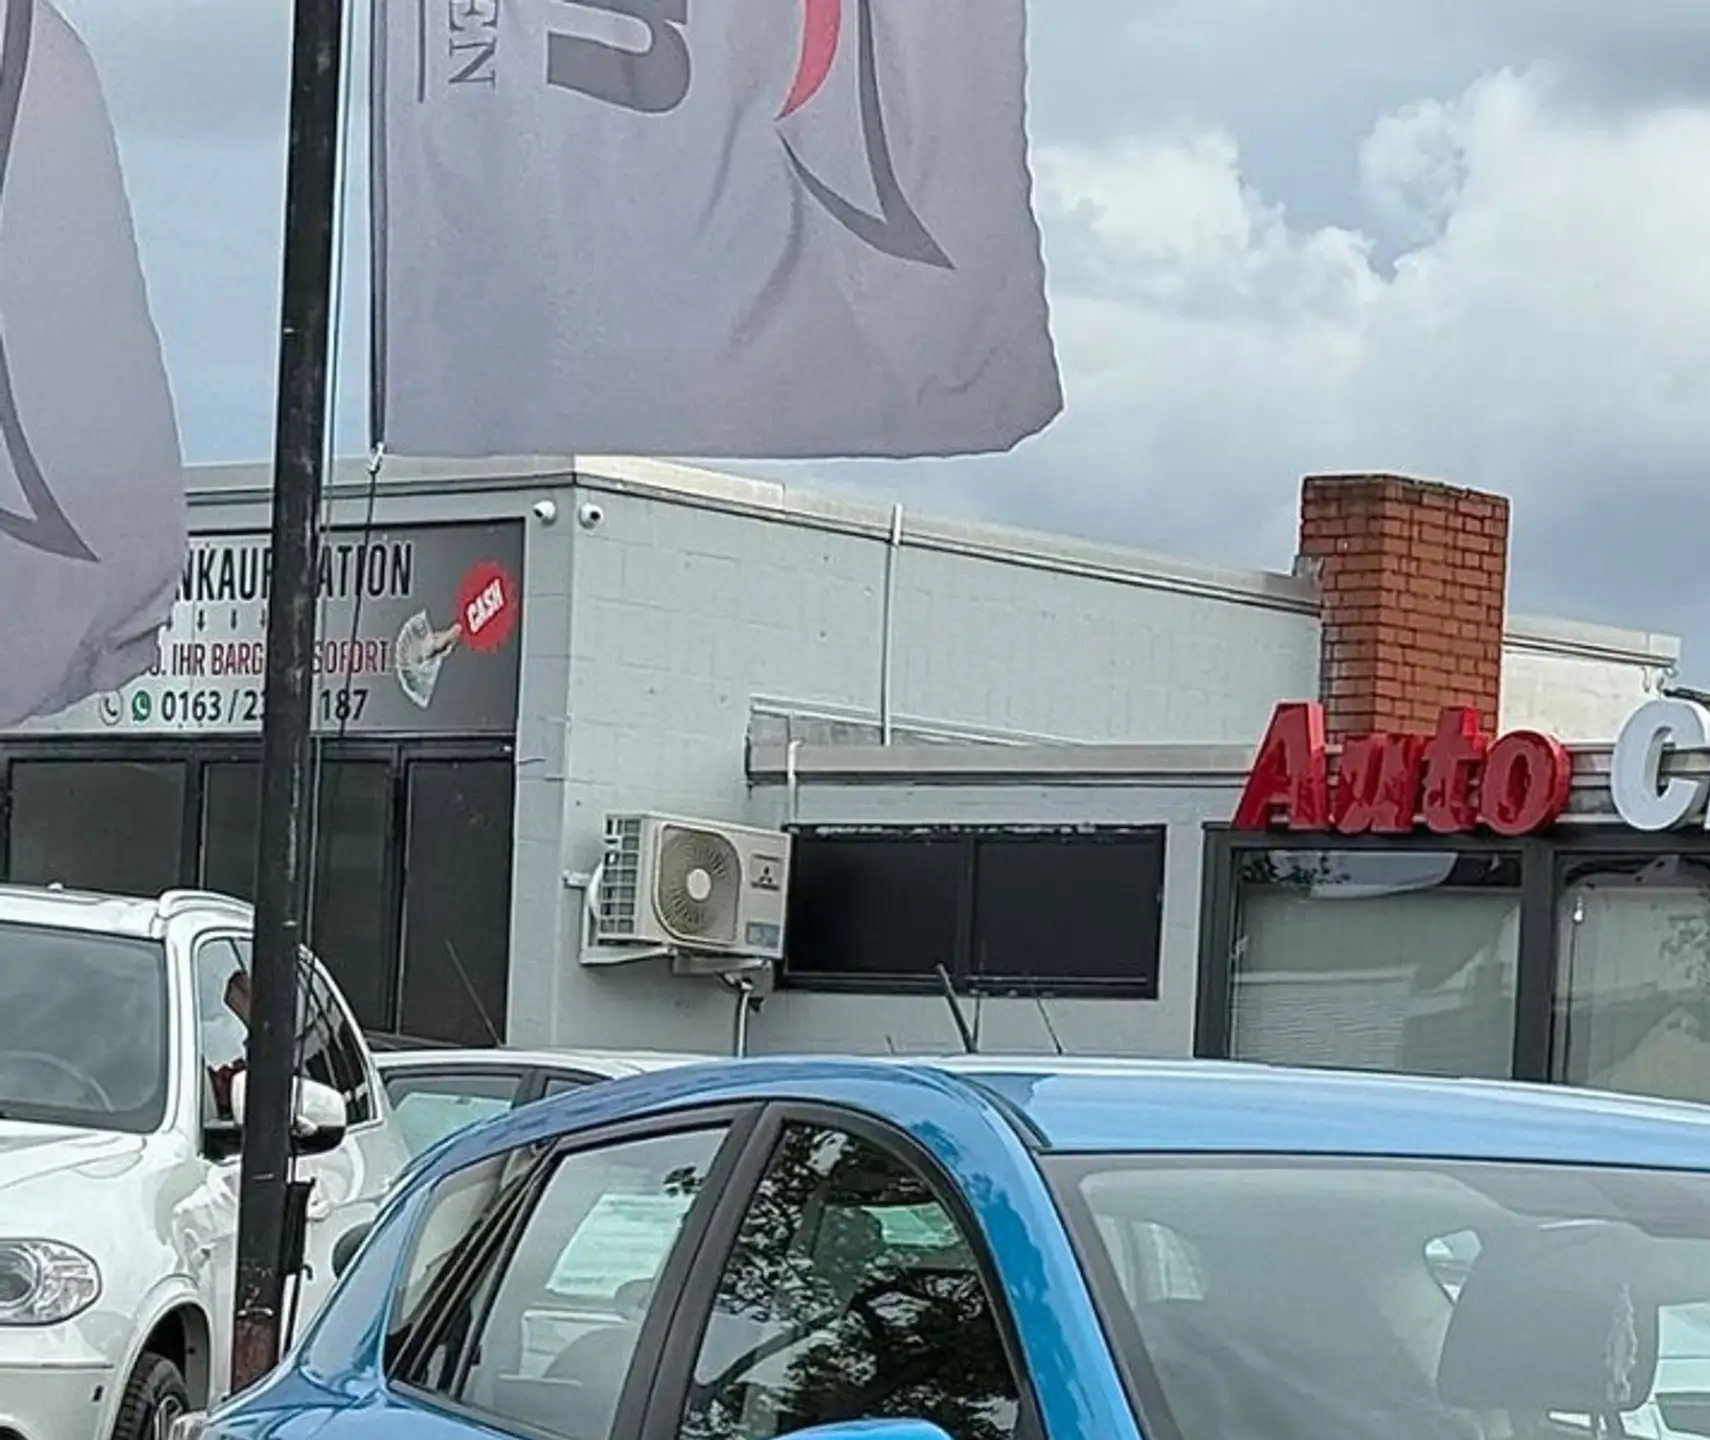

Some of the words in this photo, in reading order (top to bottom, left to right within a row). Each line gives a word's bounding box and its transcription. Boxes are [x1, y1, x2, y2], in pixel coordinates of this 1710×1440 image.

[466, 577, 505, 633] CASH
[172, 643, 206, 677] IHR
[312, 640, 388, 674] SOFORT
[161, 689, 222, 721] 0163
[1231, 700, 1571, 835] Auto
